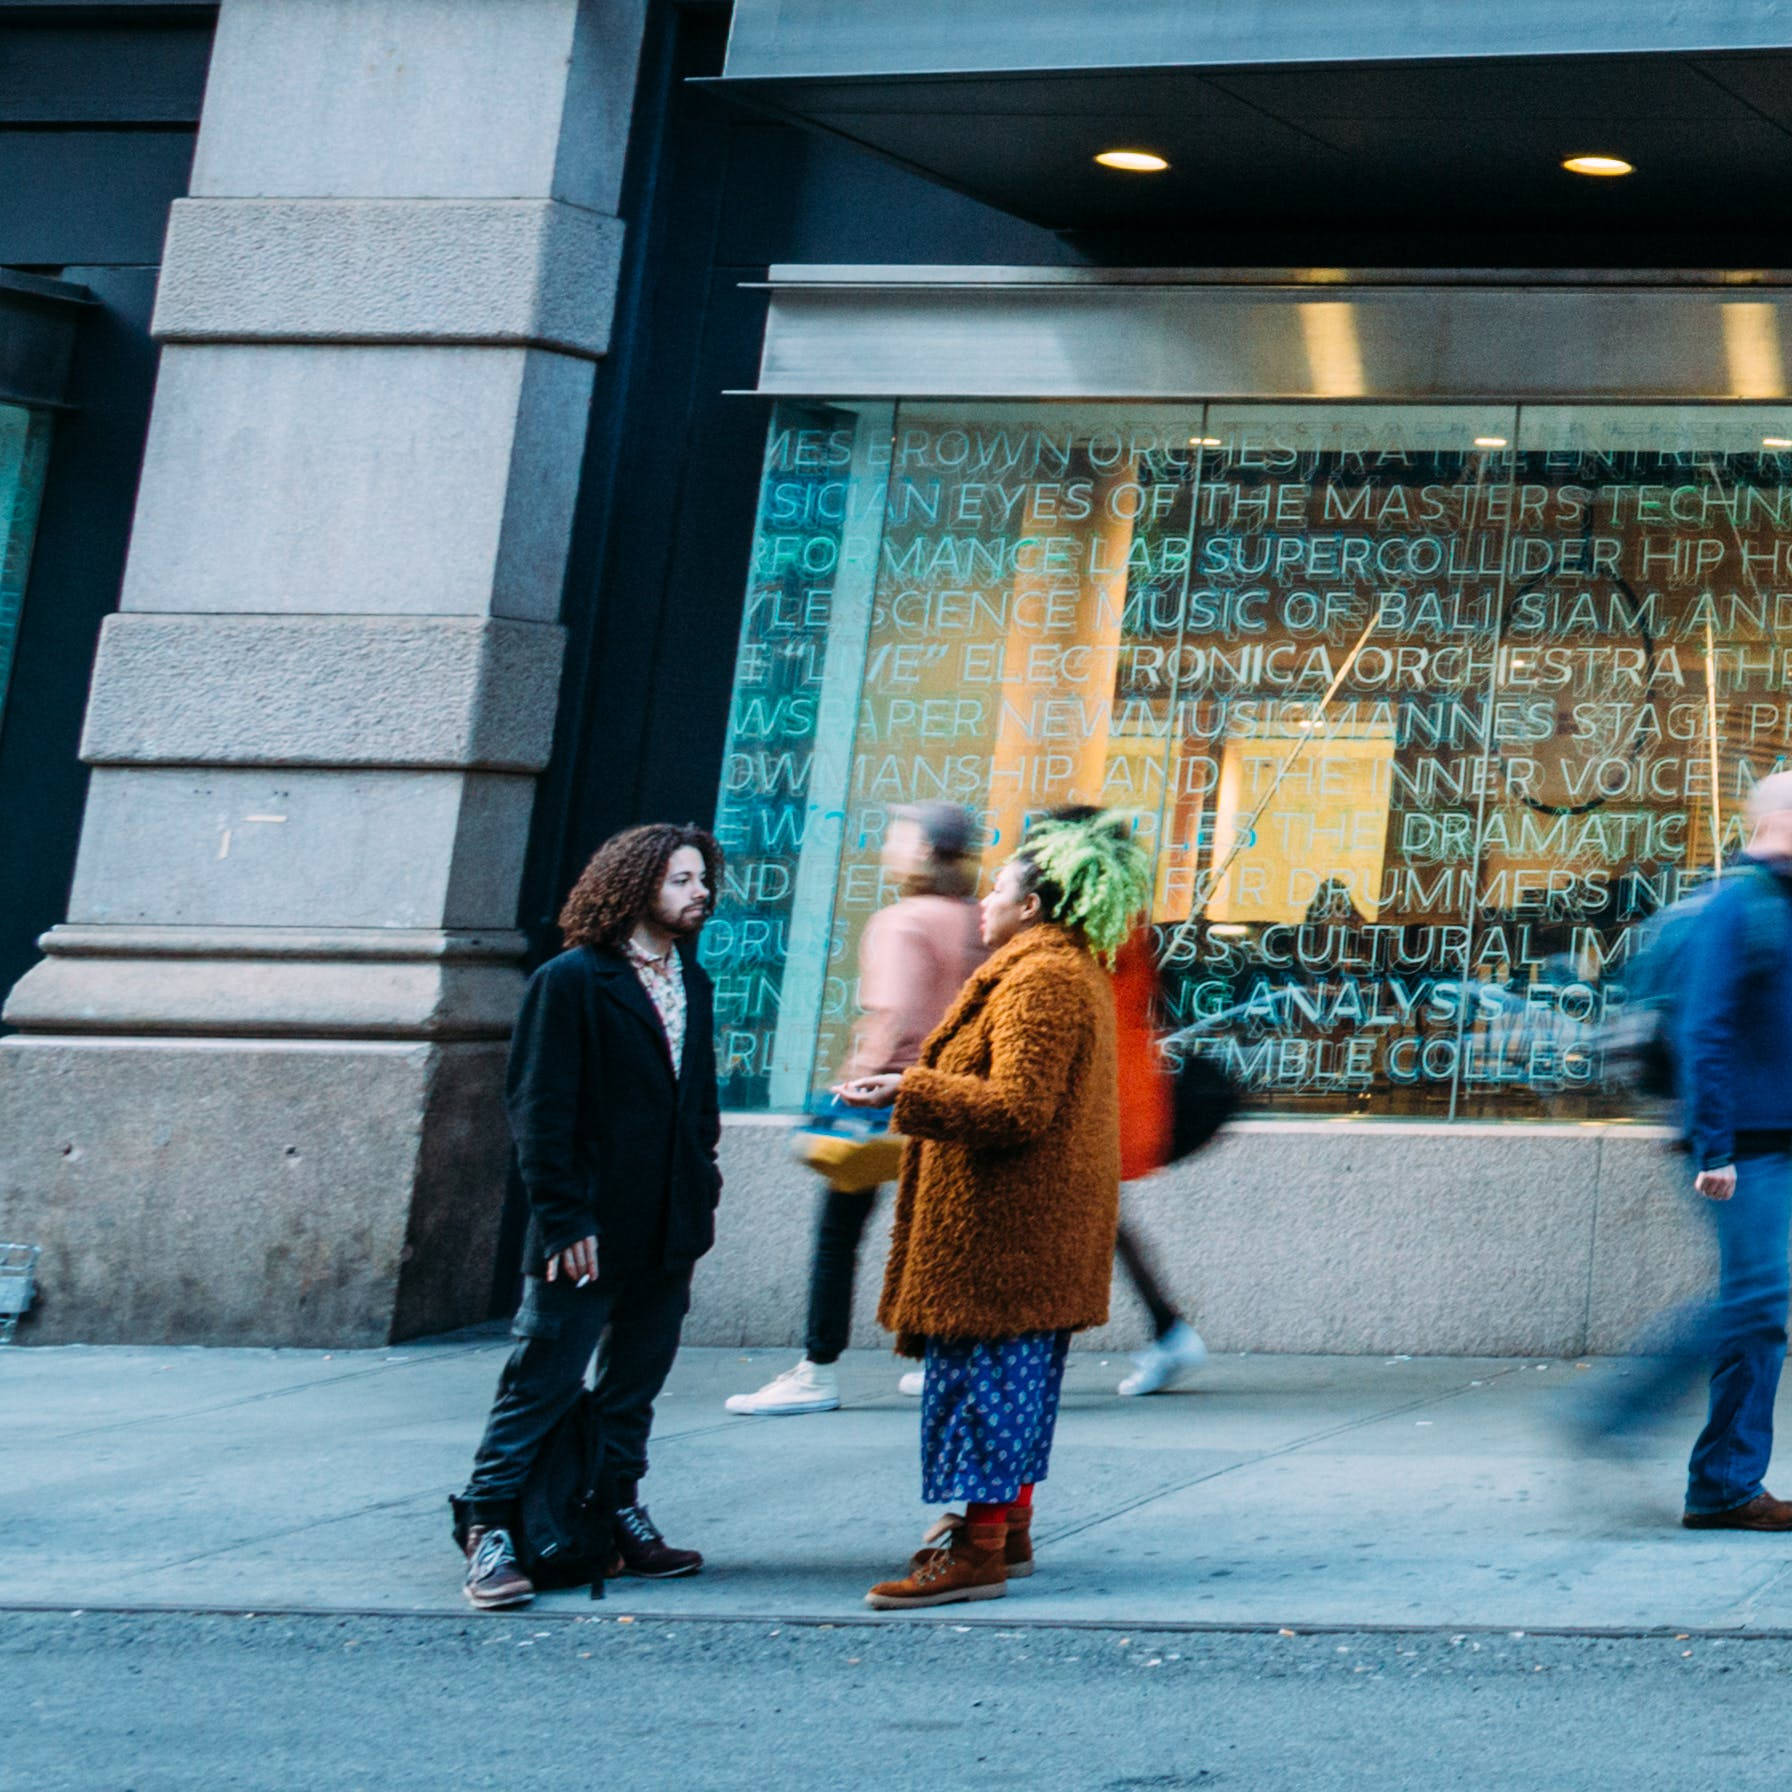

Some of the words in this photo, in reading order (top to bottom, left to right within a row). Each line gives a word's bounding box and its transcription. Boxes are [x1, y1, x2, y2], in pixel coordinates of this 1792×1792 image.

[1087, 429, 1411, 468] ORCHESTRA
[957, 484, 1094, 520] EYES
[1111, 484, 1180, 521] OF
[1200, 483, 1308, 521] THE
[1322, 484, 1593, 522] MASTERS
[1089, 537, 1190, 575] LAB
[1201, 538, 1623, 577] SUPERCOLLIDER
[1642, 539, 1726, 577] HIP
[872, 590, 1073, 629] SCIENCE
[1094, 591, 1271, 629] MUSIC
[1283, 591, 1353, 630] OF
[1376, 592, 1491, 630] BALI
[963, 644, 1334, 684] ELECTRONICA
[1351, 645, 1686, 686] ORCHESTRA
[1572, 702, 1728, 741] STAGE
[1102, 755, 1221, 794] AND
[1243, 756, 1351, 795] THE
[1372, 757, 1536, 796] INNER
[1560, 758, 1712, 798] VOICE
[1273, 811, 1382, 852] THE
[1402, 812, 1689, 853] DRAMATIC
[1163, 868, 1269, 906] FOR
[1287, 869, 1611, 909] DRUMMERS
